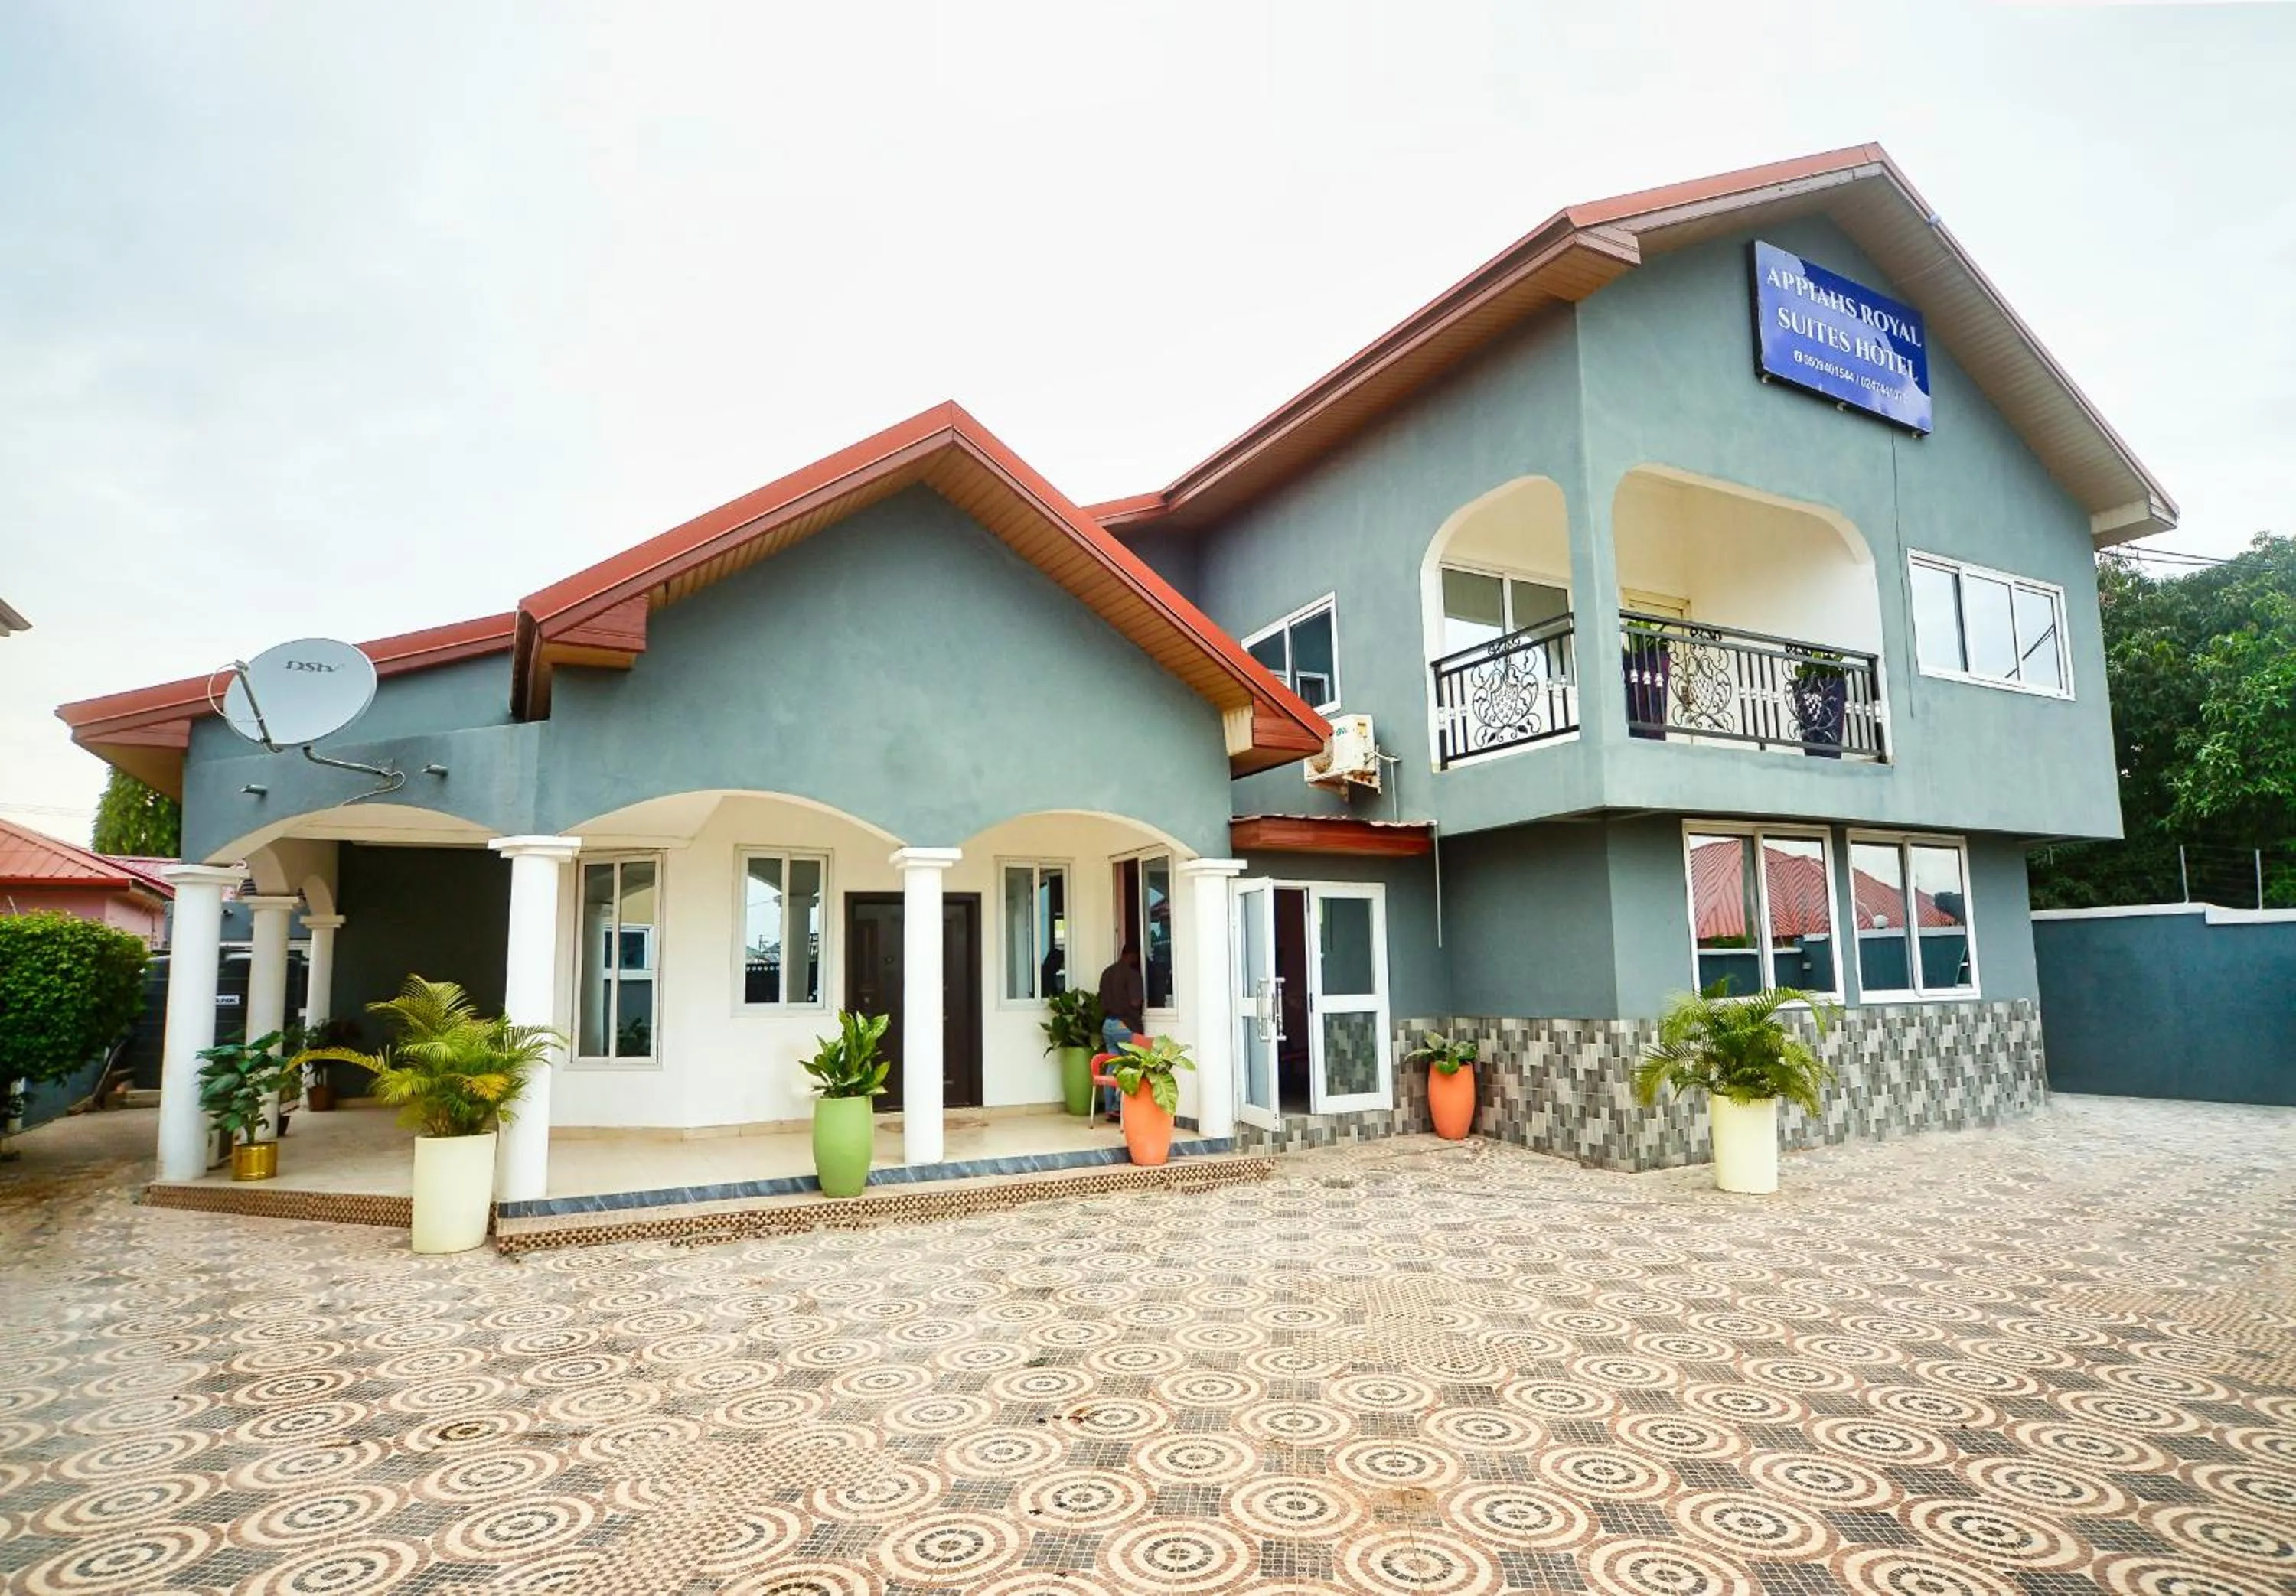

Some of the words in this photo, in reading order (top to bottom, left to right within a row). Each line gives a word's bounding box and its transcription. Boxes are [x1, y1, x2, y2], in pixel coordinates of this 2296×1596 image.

[1766, 266, 1857, 320] APPIAHS
[1859, 302, 1923, 347] ROYAL
[1777, 306, 1851, 353] SUITES
[1854, 337, 1919, 383] HOTEL
